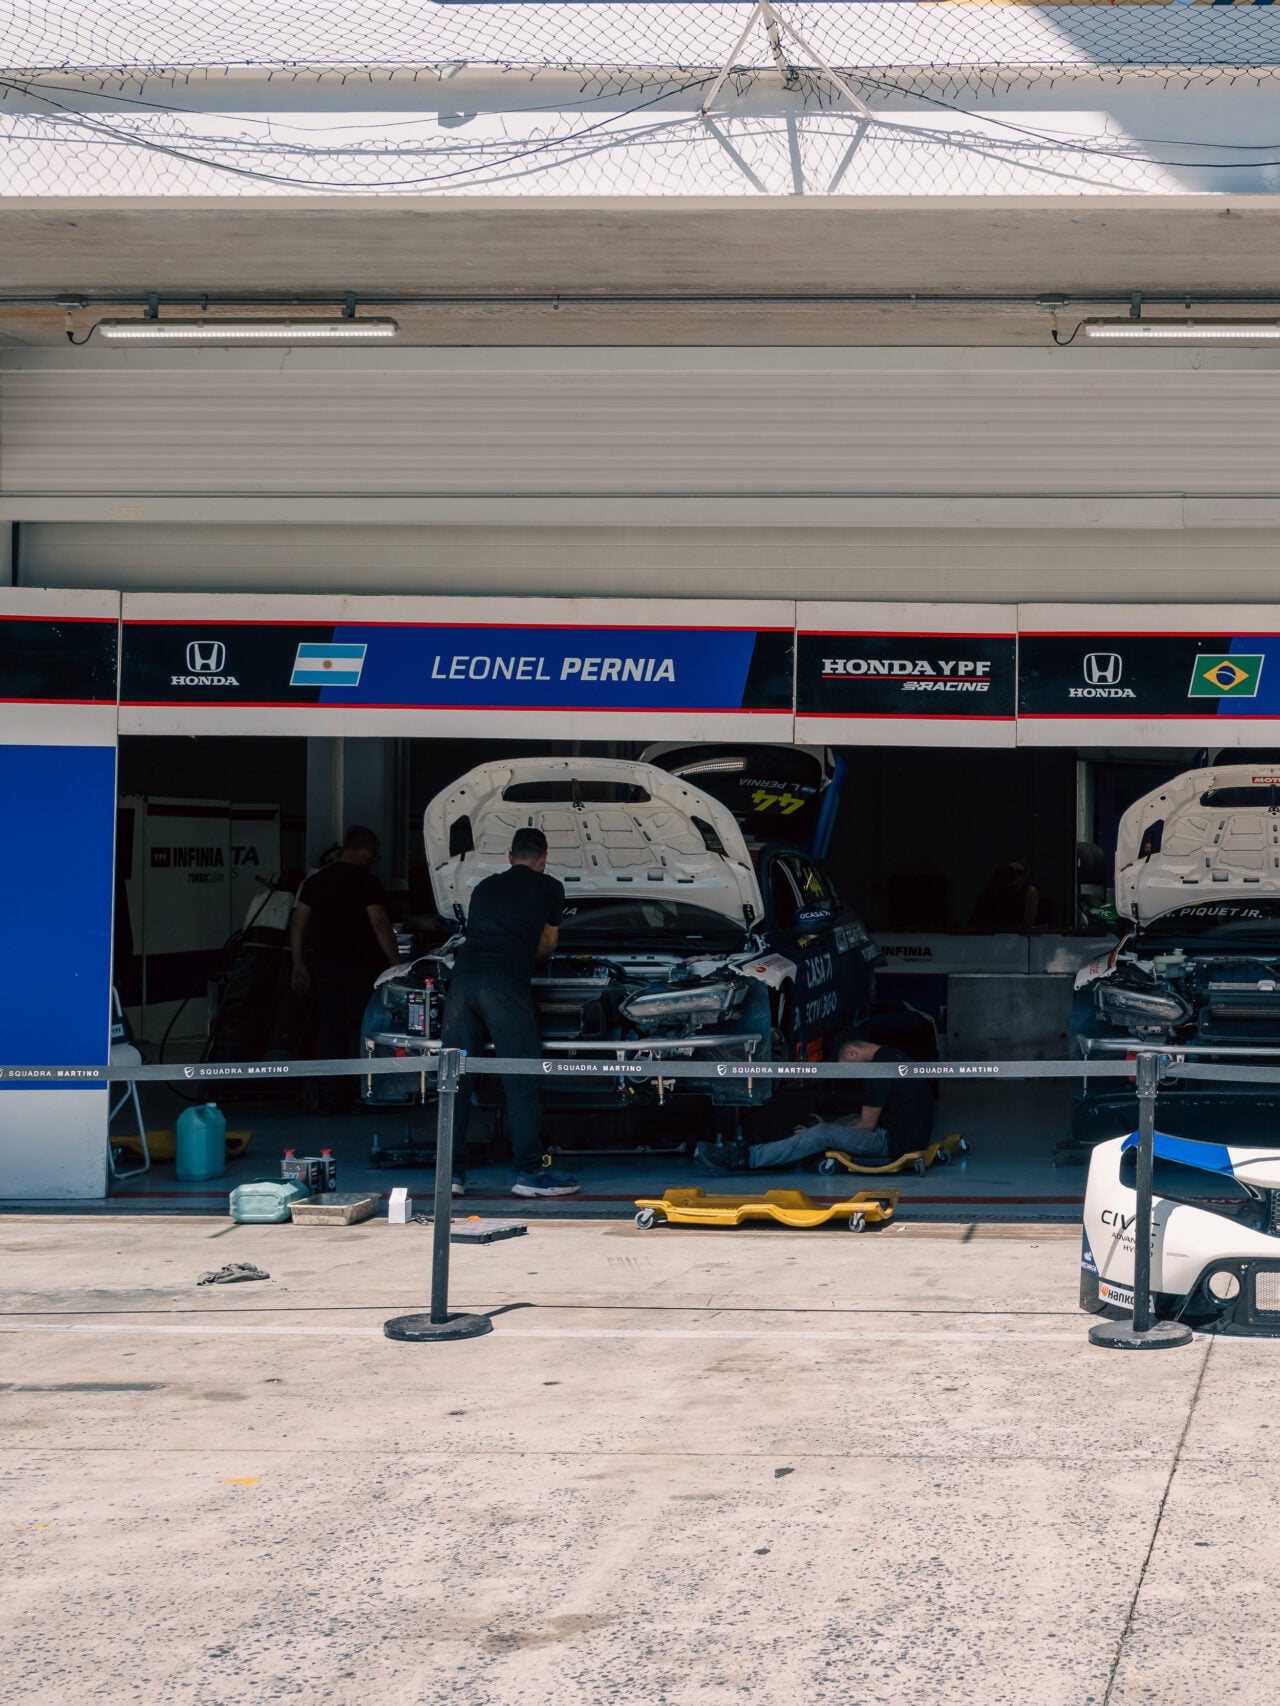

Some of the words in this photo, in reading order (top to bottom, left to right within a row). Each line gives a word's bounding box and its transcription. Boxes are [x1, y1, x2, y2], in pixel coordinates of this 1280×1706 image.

[431, 655, 551, 681] LEONEL
[560, 657, 676, 682] PERNIA
[821, 659, 936, 676] HONDA
[939, 660, 992, 676] YPF
[170, 676, 240, 686] HONDA
[1068, 688, 1137, 698] HONDA
[173, 847, 225, 867] INFINIA
[1179, 906, 1240, 917] PIQUET
[1240, 909, 1264, 918] JR.
[881, 946, 933, 957] INFINIA
[199, 1068, 243, 1076] SQUADRA
[248, 1066, 290, 1074] MARTINO
[557, 1064, 598, 1072] SQUADRA
[8, 1070, 52, 1078] SQUADRA
[1101, 1209, 1161, 1236] CIV
